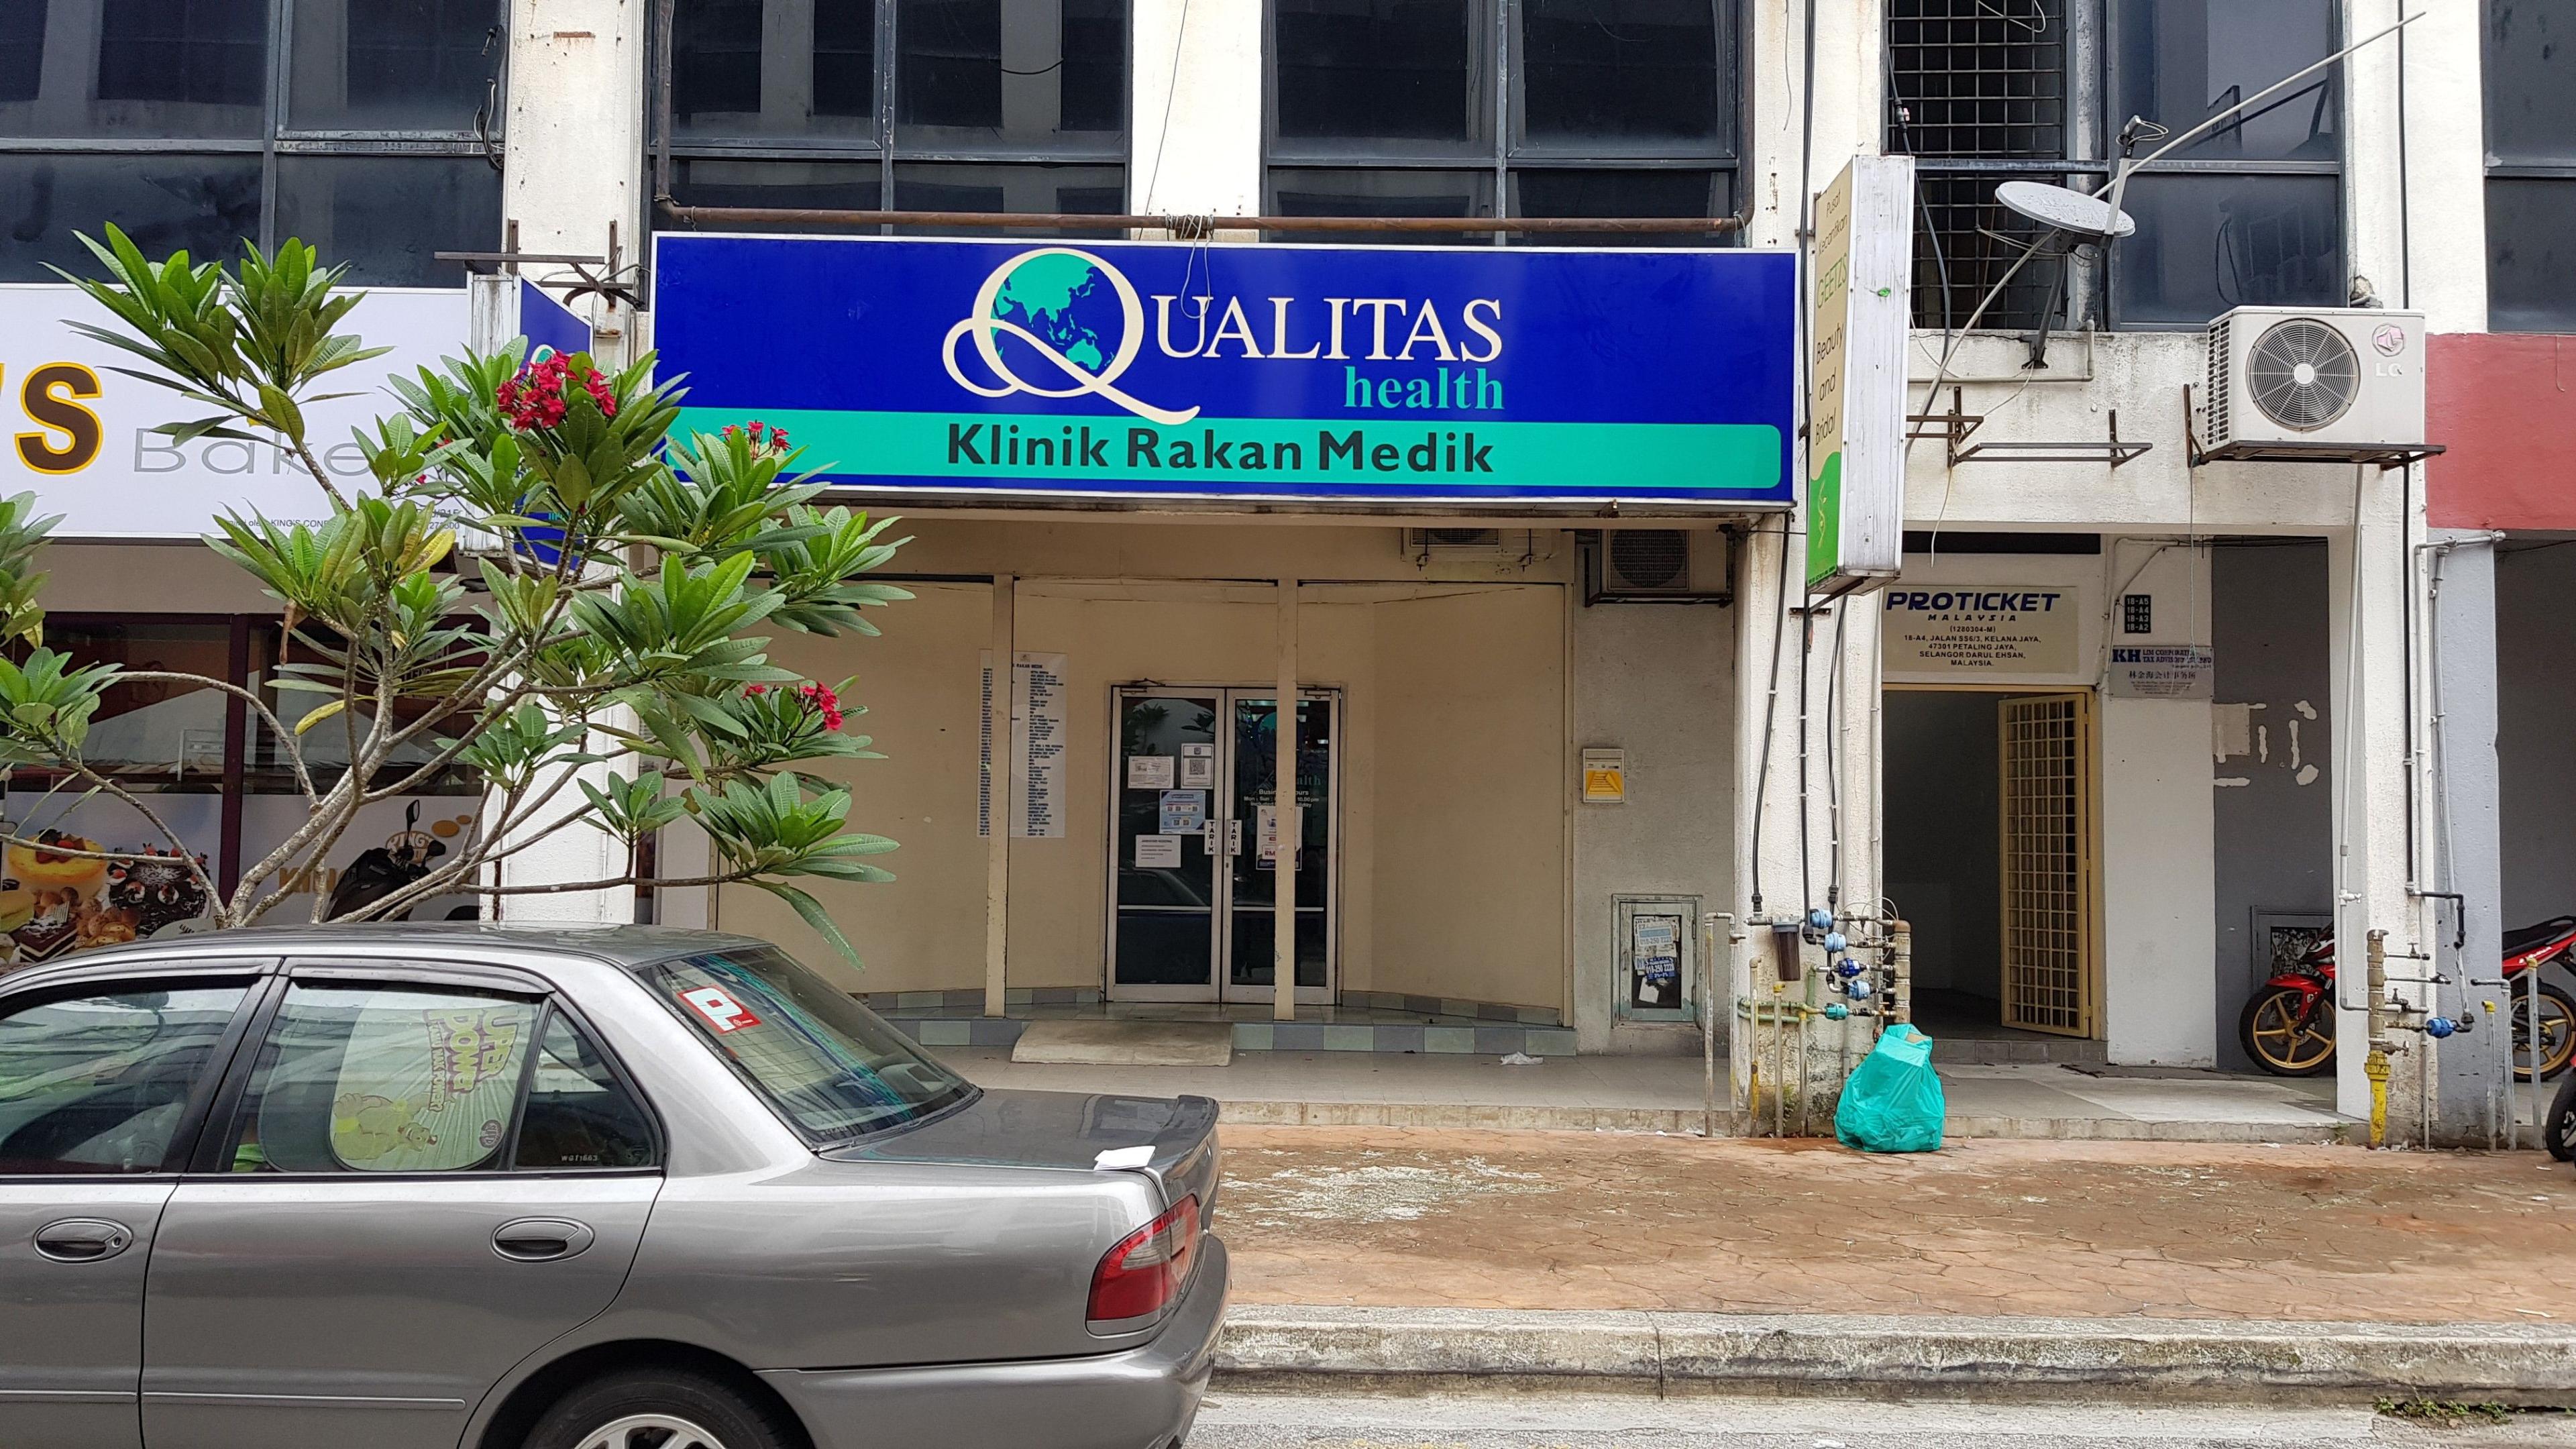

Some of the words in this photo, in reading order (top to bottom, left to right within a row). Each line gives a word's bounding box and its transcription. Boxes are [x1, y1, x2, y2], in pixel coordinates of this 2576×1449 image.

[1827, 188, 1841, 217] Pusat
[943, 247, 1503, 425] QUALITAS
[1817, 322, 1844, 365] Beauty
[1343, 366, 1505, 410] health
[1819, 366, 1836, 401] and
[0, 362, 103, 475] S
[1816, 407, 1836, 445] Bridal
[134, 427, 370, 476] Bake
[948, 423, 1112, 468] Klinik
[1127, 427, 1301, 470] Rakan
[1318, 430, 1495, 473] Medik
[1886, 592, 2061, 612] PROTICKET
[2112, 649, 2141, 663] KH
[683, 987, 743, 1031] P
